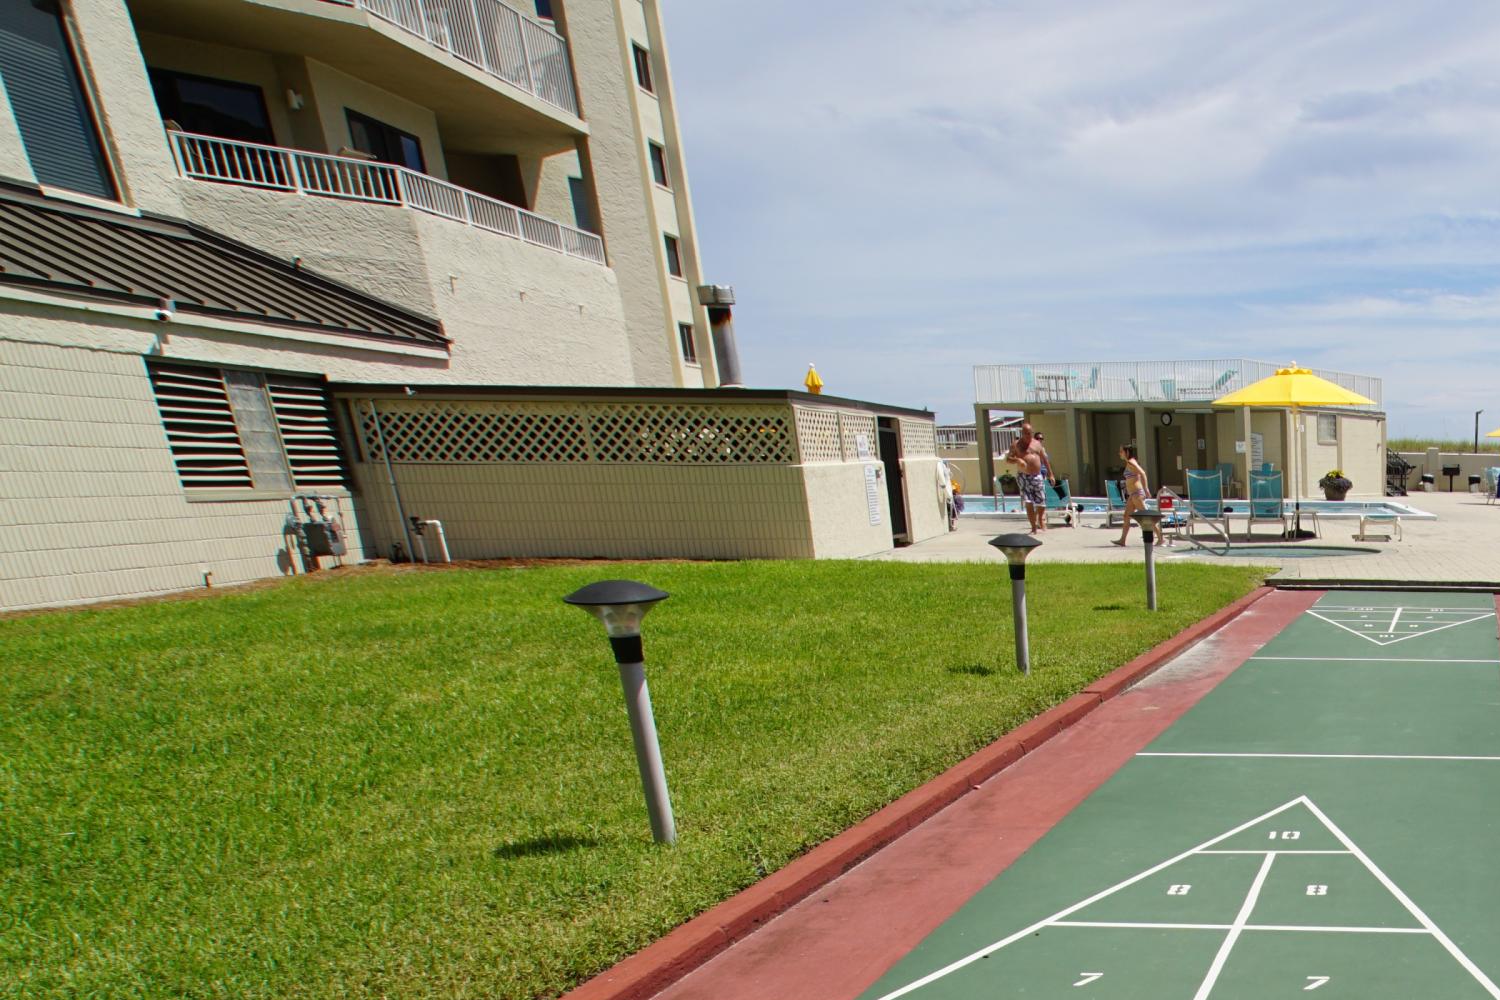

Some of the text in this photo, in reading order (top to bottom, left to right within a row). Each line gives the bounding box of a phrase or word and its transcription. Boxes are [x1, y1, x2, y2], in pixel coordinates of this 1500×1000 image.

[1268, 830, 1301, 840] 10
[1166, 884, 1192, 896] 8
[1305, 884, 1329, 896] 8
[1072, 972, 1104, 987] 7
[1303, 975, 1330, 990] 7
